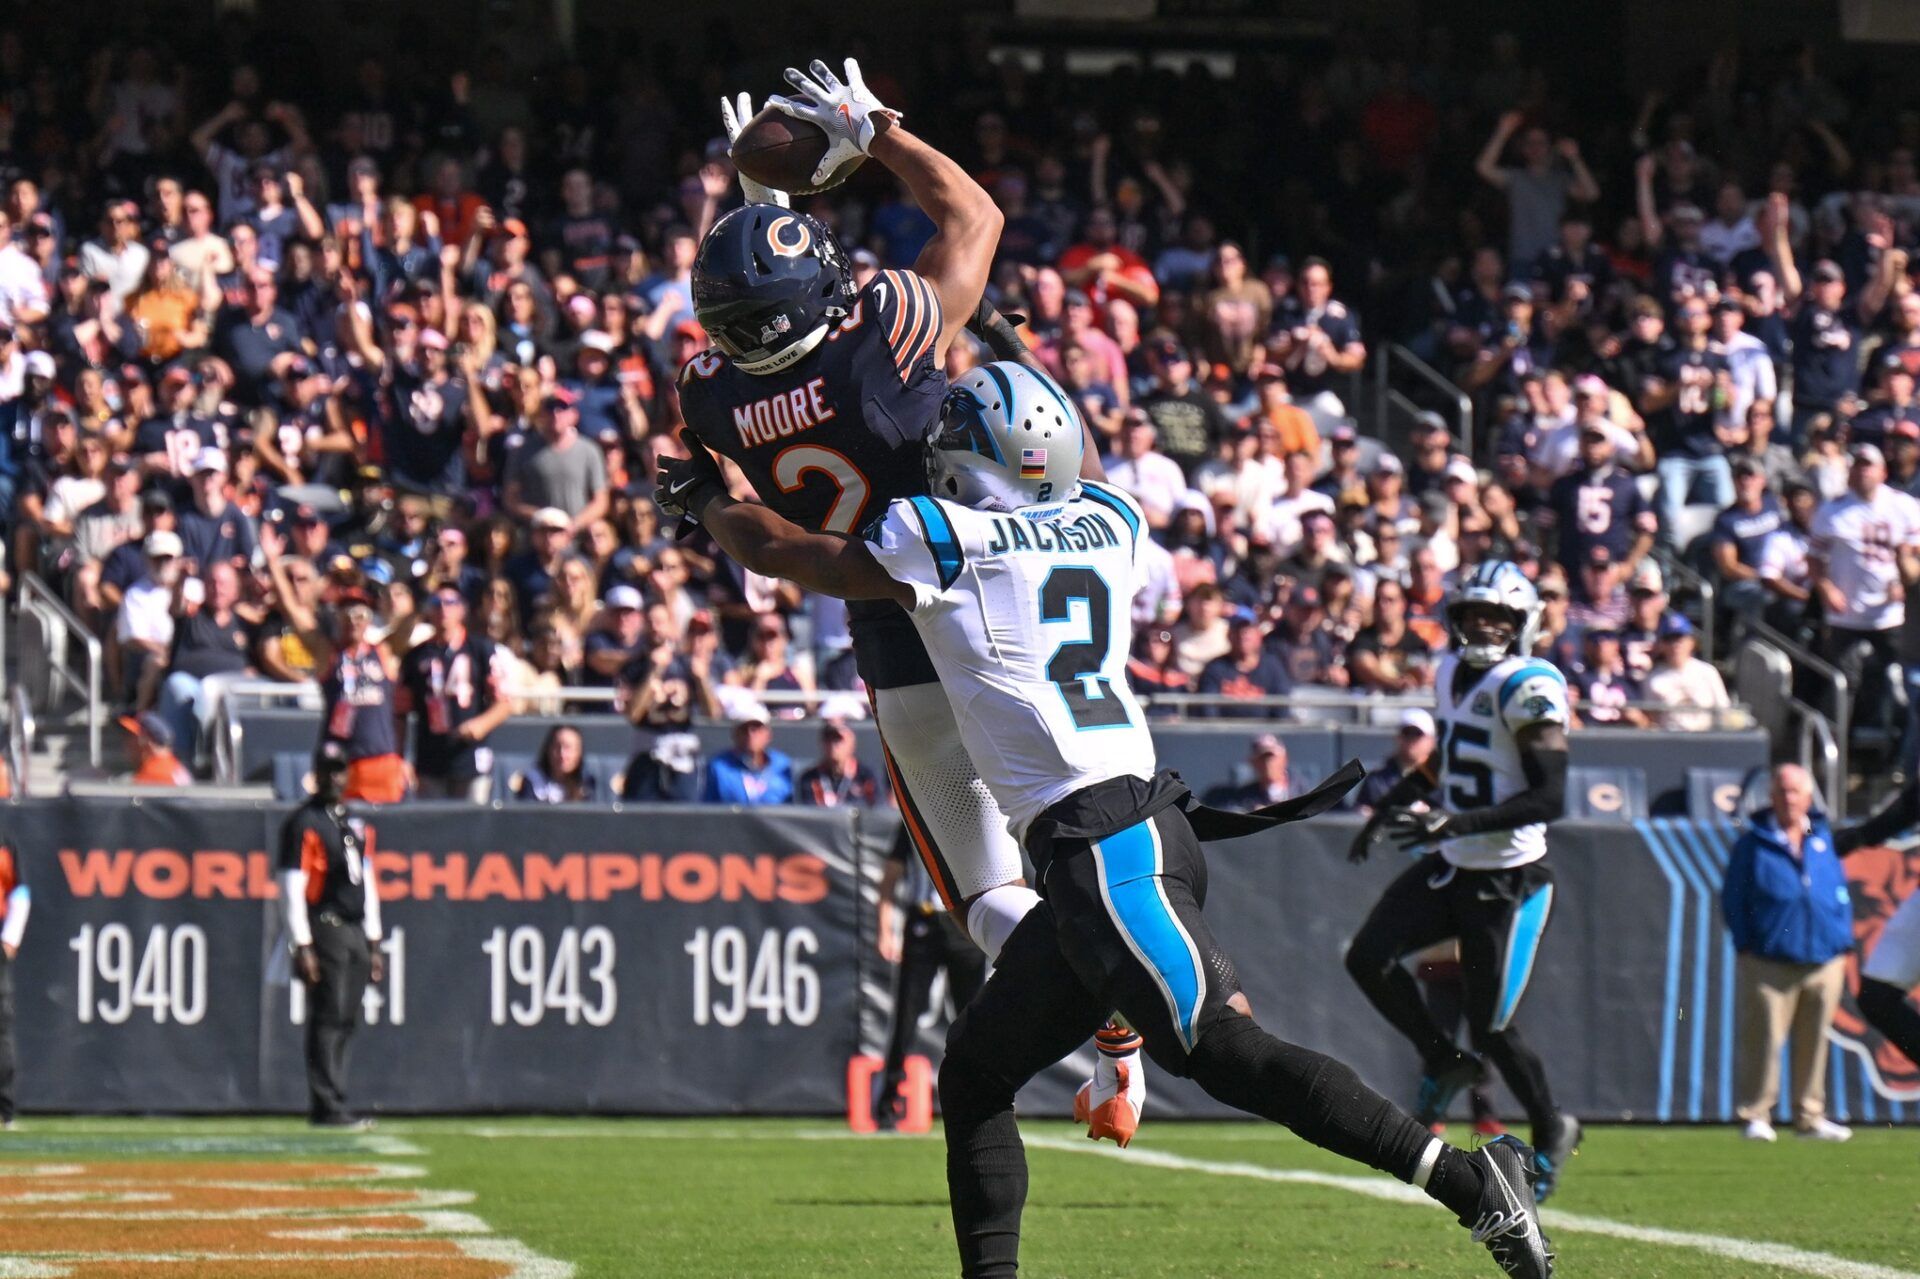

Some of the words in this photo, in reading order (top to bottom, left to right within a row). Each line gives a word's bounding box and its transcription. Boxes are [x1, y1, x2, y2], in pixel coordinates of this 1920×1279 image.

[773, 350, 798, 366] LOVE
[732, 376, 836, 448] MOORE
[771, 443, 872, 534] 2
[1037, 482, 1053, 502] 2
[989, 513, 1120, 555] JACKSON
[1038, 565, 1134, 732] 2
[58, 849, 281, 899] WORL
[376, 850, 829, 905] CHAMPIONS
[69, 922, 208, 1026] 1940
[481, 925, 617, 1027] 1943
[684, 926, 821, 1028] 1946
